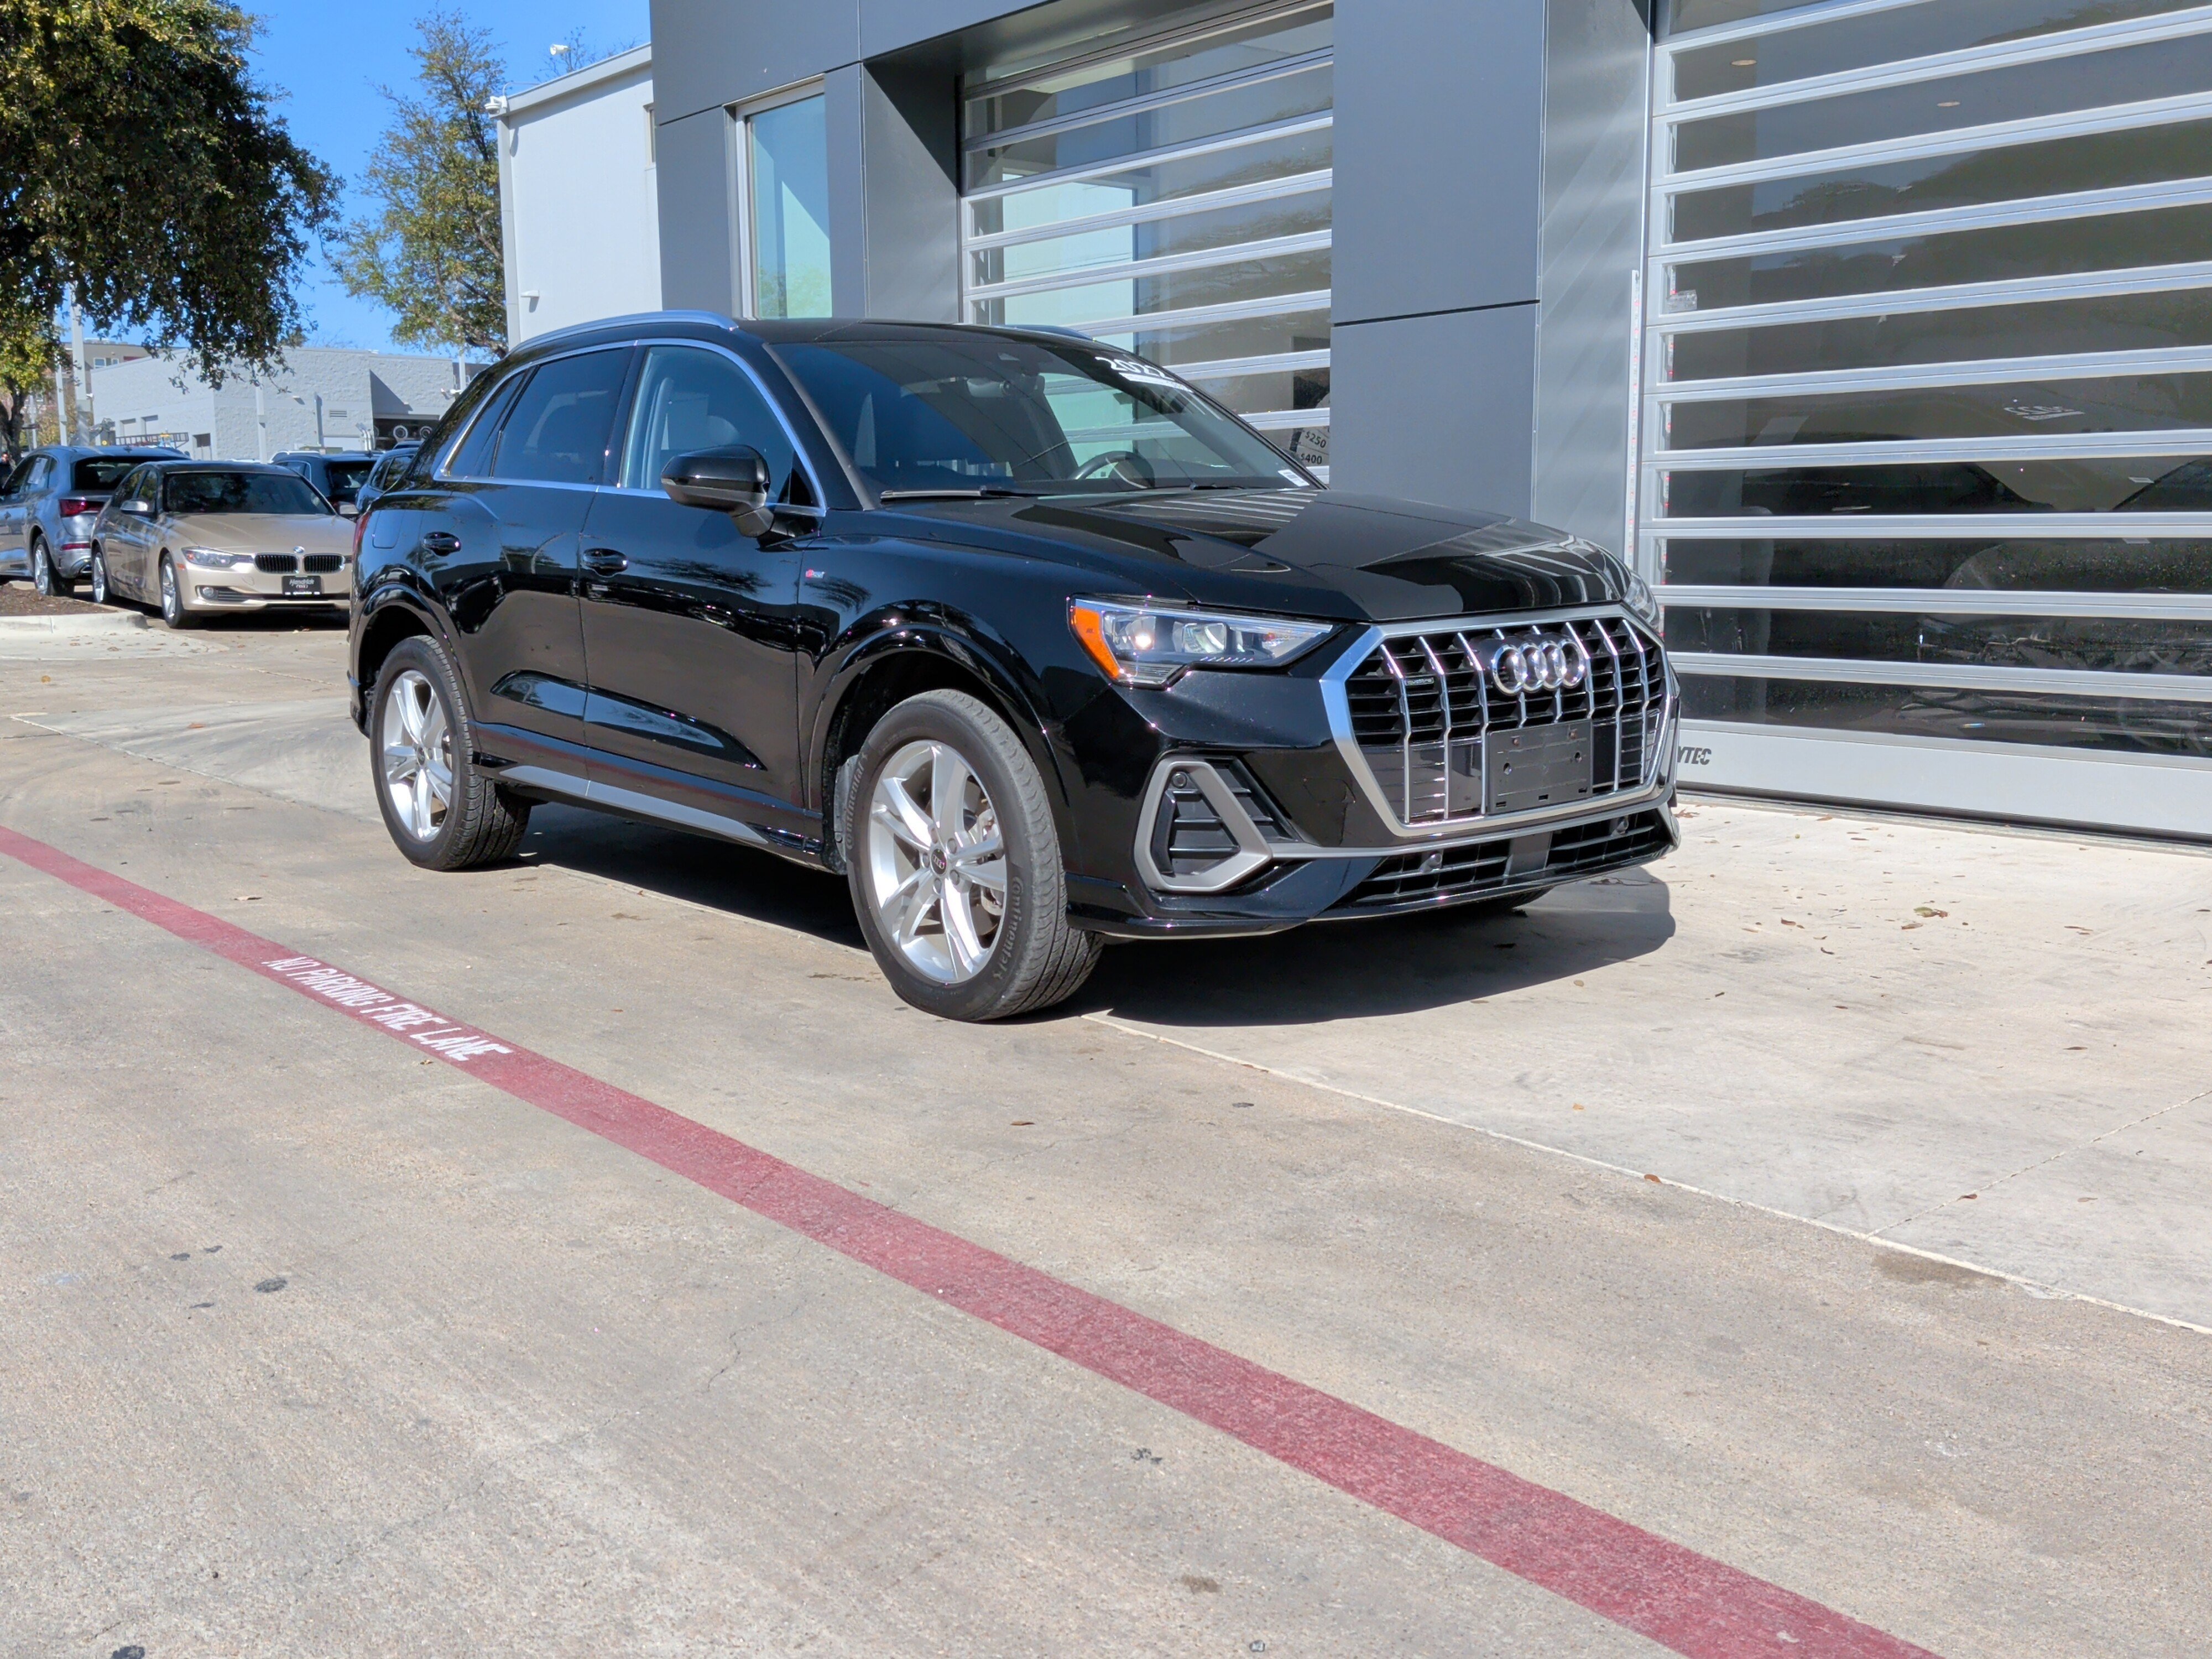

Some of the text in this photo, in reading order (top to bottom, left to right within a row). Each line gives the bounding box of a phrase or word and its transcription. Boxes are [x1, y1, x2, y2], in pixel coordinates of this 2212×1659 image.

[1305, 431, 1327, 448] $250
[1301, 453, 1322, 465] $400
[1677, 746, 1712, 765] YTEC
[261, 957, 513, 1061] NO PARKING FIRE LANE
